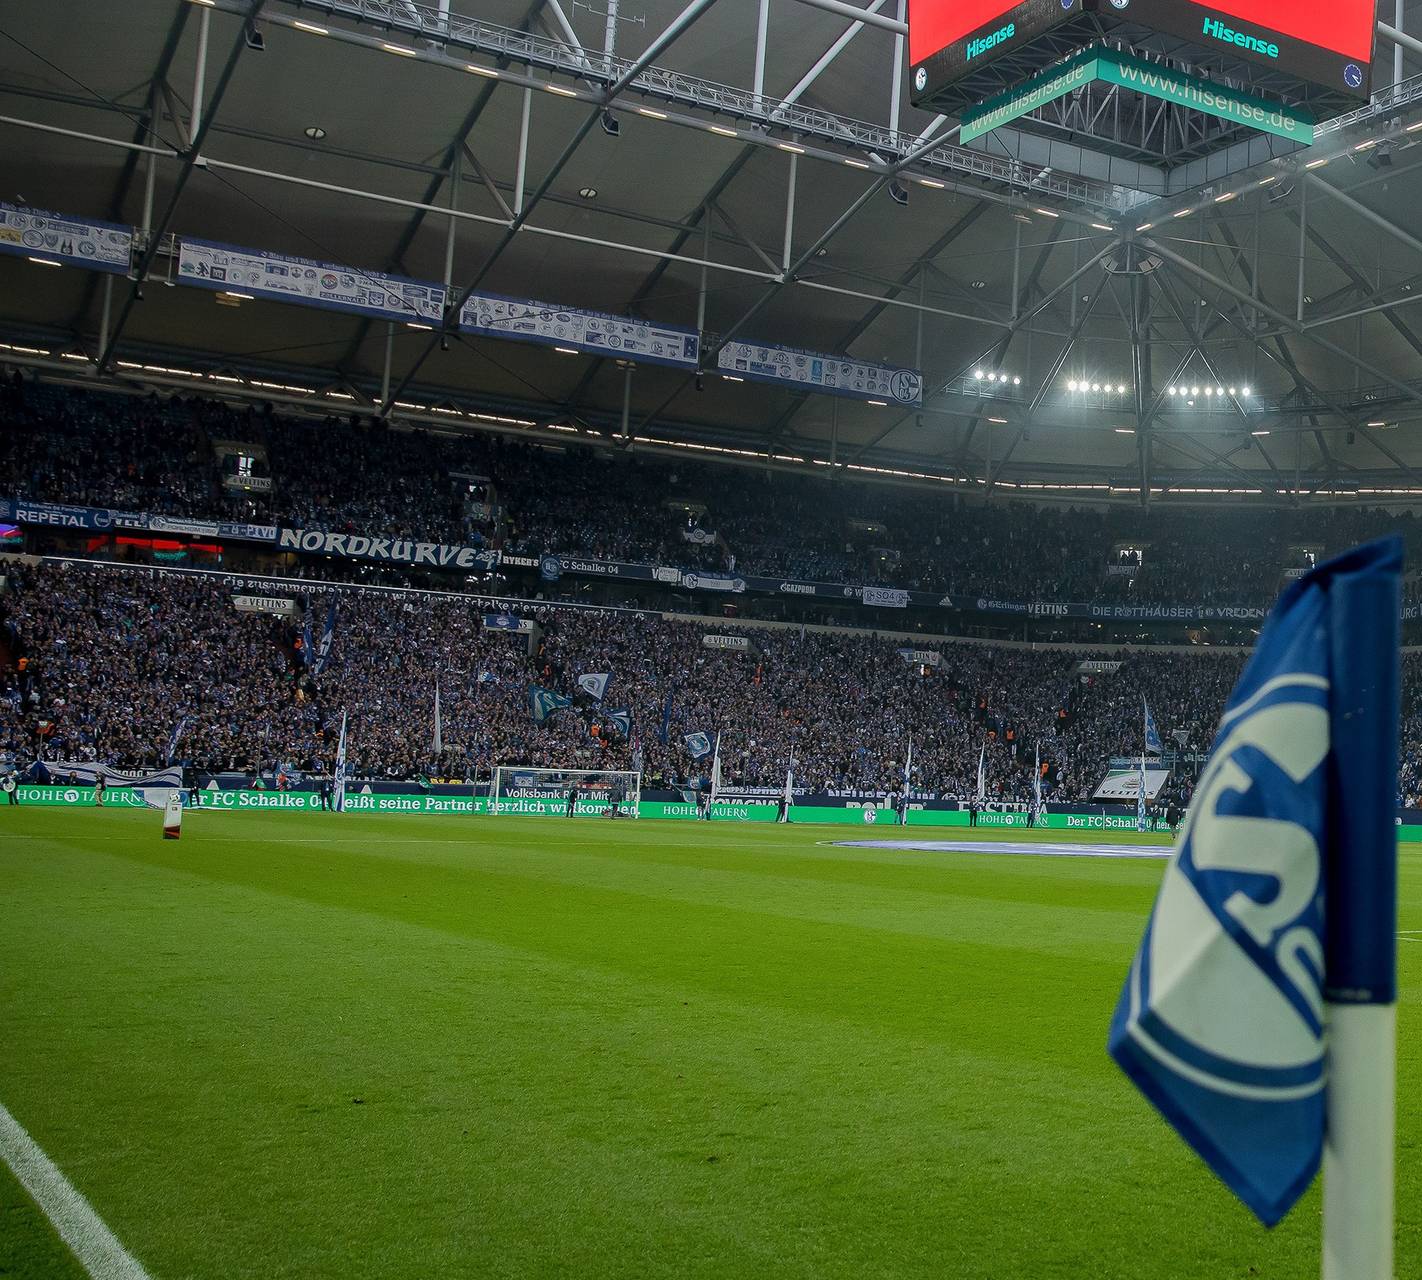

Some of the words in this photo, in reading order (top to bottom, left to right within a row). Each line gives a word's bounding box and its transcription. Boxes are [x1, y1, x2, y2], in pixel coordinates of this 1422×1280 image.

[966, 22, 1015, 60] Hisense
[1202, 17, 1279, 58] Hisense
[970, 62, 1084, 131] www.hisense.de
[1119, 62, 1296, 131] www.hisense.de
[240, 478, 272, 488] VELTINS
[16, 510, 88, 528] REPETAL
[280, 528, 477, 567] NORDKURVE
[571, 561, 606, 573] Schalke
[608, 564, 619, 575] 04
[250, 597, 287, 609] VELTINS
[1028, 603, 1068, 615] VELTINS
[1092, 606, 1111, 617] DIE
[714, 636, 743, 646] VELTINS
[16, 790, 63, 801] HOHE
[506, 787, 562, 799] Volksbank
[212, 792, 234, 806] FC
[239, 792, 305, 807] Schalke
[379, 798, 421, 810] seine
[424, 797, 482, 812] Partner
[486, 799, 546, 814] herzlich
[663, 806, 695, 815] HOHE
[979, 815, 1006, 824] HOHE
[1067, 816, 1086, 827] Der
[1087, 817, 1103, 828] FC
